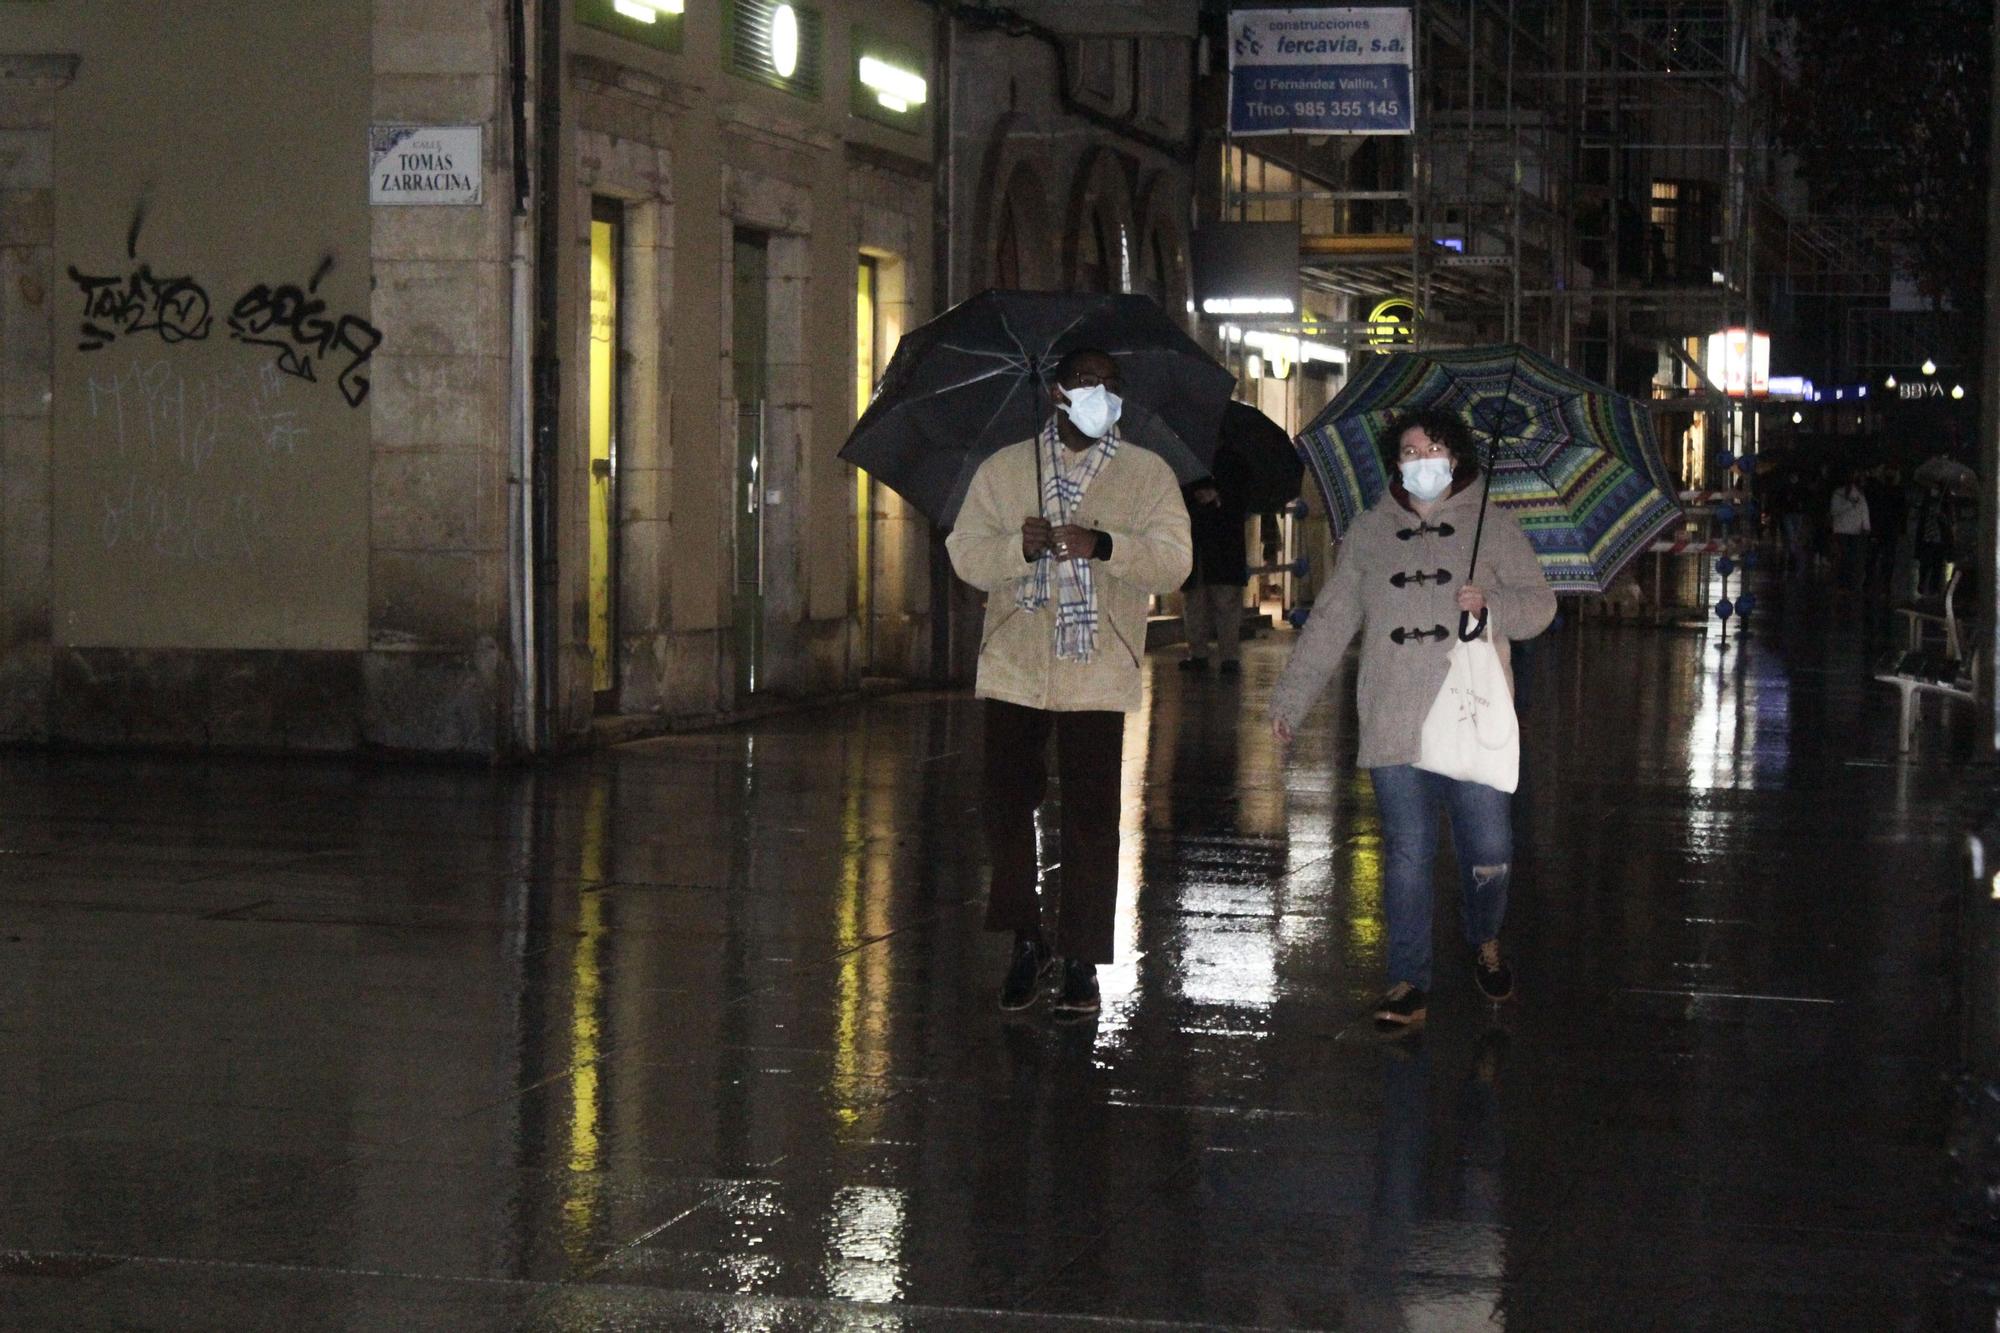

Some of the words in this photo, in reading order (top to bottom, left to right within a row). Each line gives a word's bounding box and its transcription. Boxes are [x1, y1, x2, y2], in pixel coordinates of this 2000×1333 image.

[1269, 19, 1370, 31] construcciones
[1277, 35, 1363, 55] fercavia,
[1370, 37, 1405, 53] s.a.
[1382, 78, 1389, 89] 1
[1246, 102, 1289, 118] Tfno.
[1295, 102, 1326, 117] 985
[1331, 102, 1362, 116] 355
[1368, 101, 1399, 116] 145
[381, 174, 471, 191] ZARRACINA
[1899, 382, 1944, 399] BBVA
